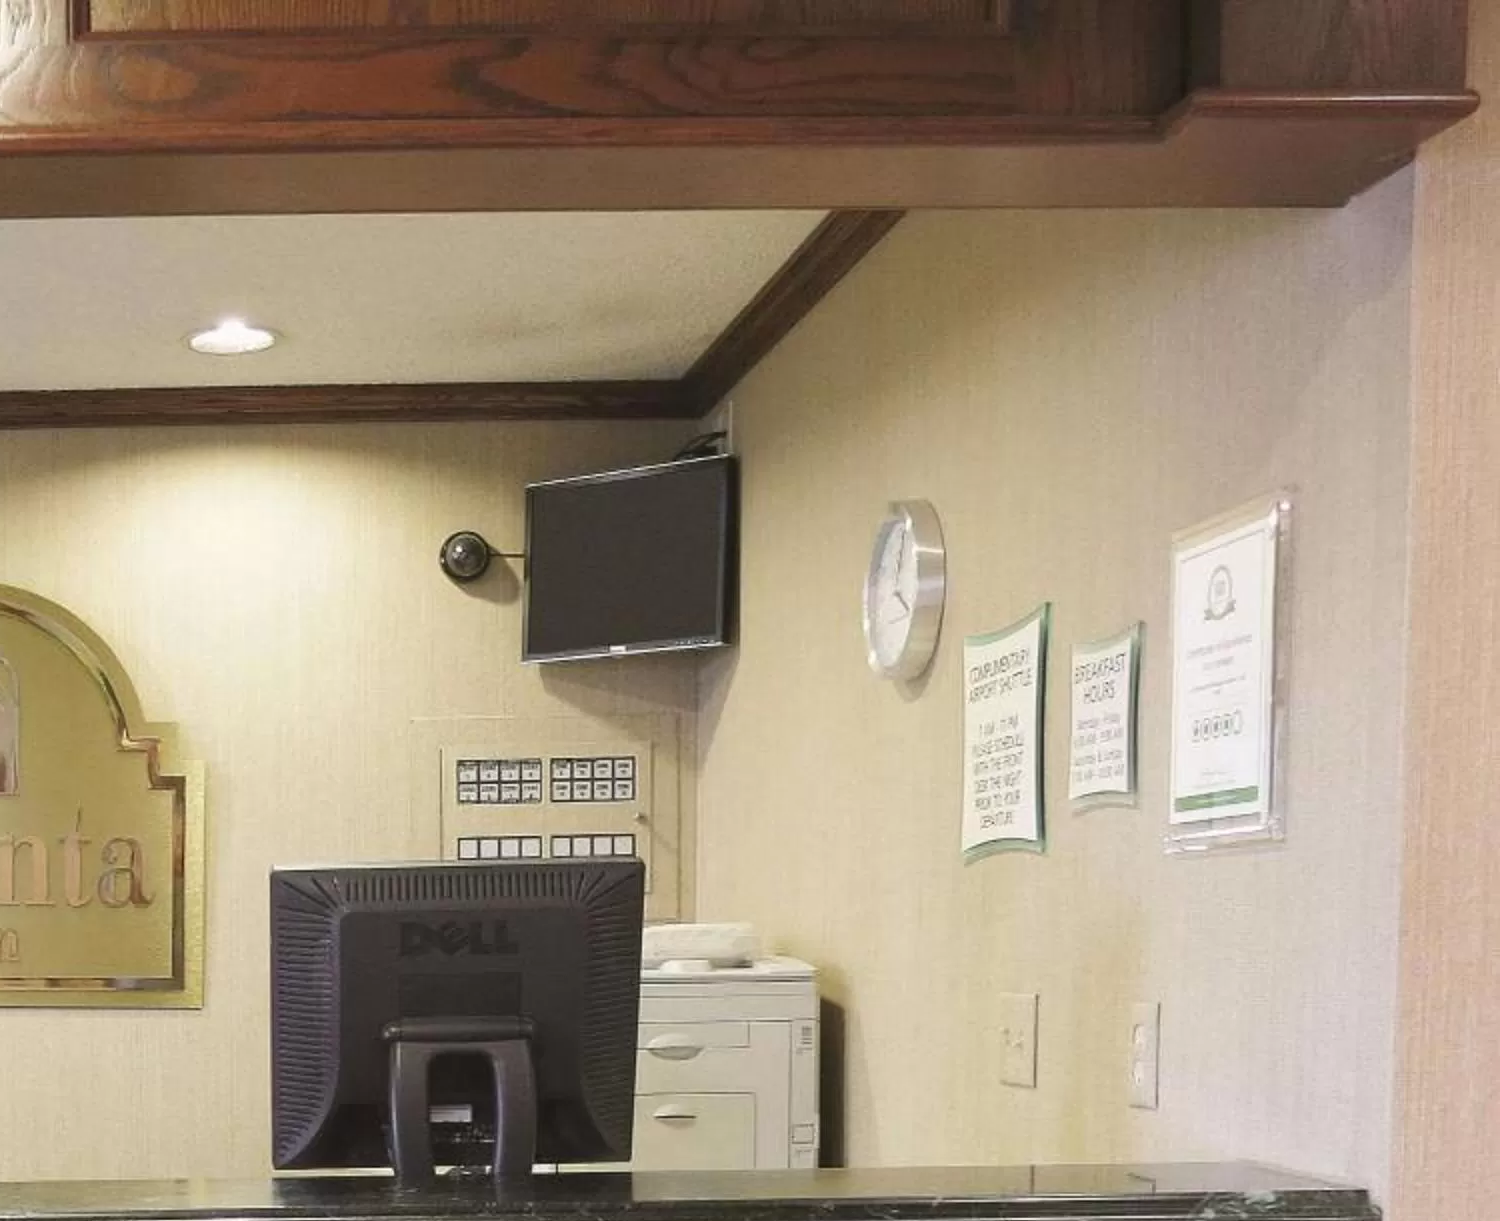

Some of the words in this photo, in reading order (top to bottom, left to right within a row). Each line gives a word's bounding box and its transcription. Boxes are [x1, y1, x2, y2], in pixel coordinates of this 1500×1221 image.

[1075, 652, 1126, 684] BREAKFAST
[1083, 680, 1115, 704] HOURS
[399, 920, 520, 956] DELL
